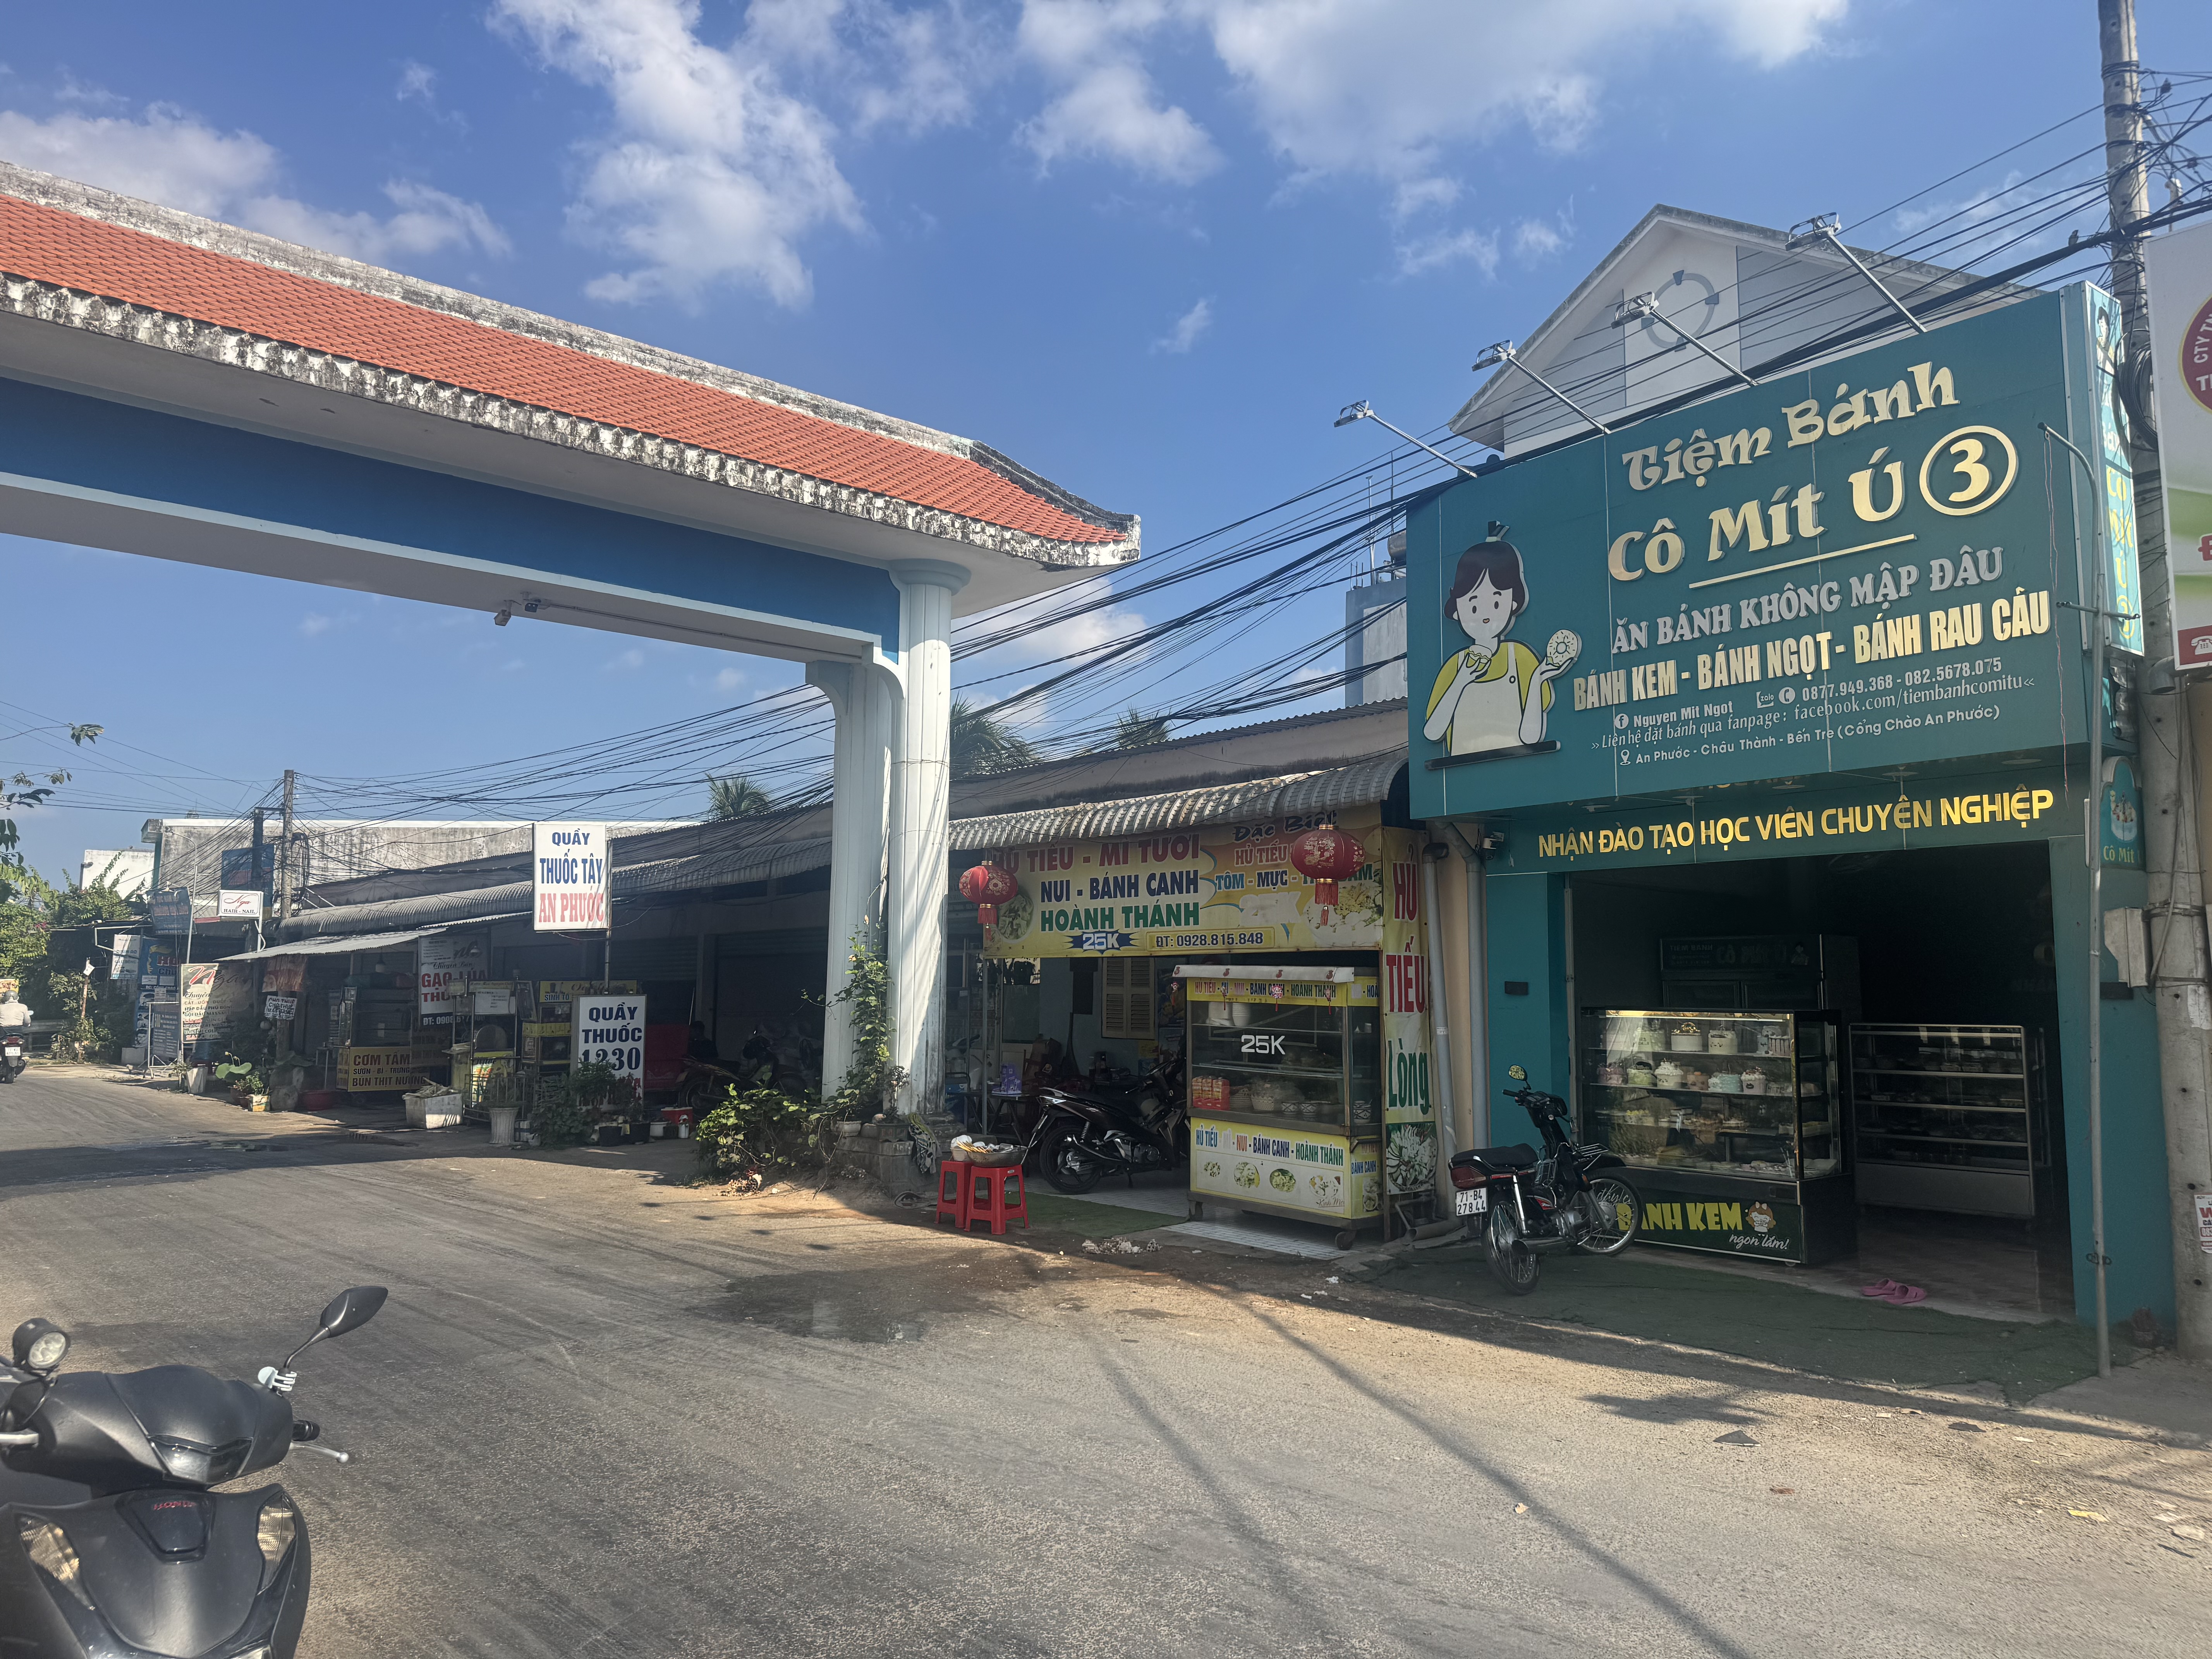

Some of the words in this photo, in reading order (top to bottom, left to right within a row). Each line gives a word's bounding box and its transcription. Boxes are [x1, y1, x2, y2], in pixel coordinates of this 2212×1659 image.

[1622, 427, 1772, 491] Tiệm
[1782, 361, 1960, 448] Bánh
[1608, 517, 1685, 581] Cô
[1708, 483, 1827, 561] Mít
[1848, 446, 1905, 522] Ú
[1948, 438, 1991, 502] 3
[1612, 618, 1649, 654] ĂN
[1657, 603, 1732, 644] BÁNH
[1740, 582, 1842, 629] KHÔNG
[1850, 562, 1919, 610] MẬP
[1930, 544, 2003, 591] ĐÂU
[1573, 669, 1627, 711] BÁNH
[1632, 659, 1678, 701] KEM
[1697, 644, 1761, 690] BÁNH
[1767, 631, 1832, 680] NGỌT
[1853, 613, 1922, 664] BÁNH
[1930, 603, 1983, 651] RAU
[1992, 586, 2051, 641] CÂU
[1760, 693, 1774, 702] zalo
[1802, 675, 1893, 702] 0877.949.368
[1905, 657, 2002, 686] 082.5678.075
[1602, 731, 1626, 748] Liên
[1628, 730, 1642, 748] hệ
[1644, 725, 1663, 745] đặt
[1666, 720, 1696, 739] bánh
[1700, 721, 1722, 738] qua
[1795, 675, 2022, 720] facebook.com/tiembanhcomitu
[1634, 711, 1677, 728] Nguyen
[1636, 752, 1651, 764] An
[1654, 746, 1691, 762] Phước
[1701, 741, 1734, 755] Châu
[1739, 736, 1776, 750] Thành
[1787, 728, 1810, 745] Bến
[1815, 728, 1834, 742] Tre
[1837, 719, 1881, 740] (Cổng
[1885, 715, 1922, 731] Chào
[1924, 712, 1944, 726] An
[1947, 704, 2000, 724] Phước)
[552, 828, 591, 847] QUẦY
[1233, 822, 1275, 842] Đặc
[1539, 826, 1594, 861] NHẬN
[1598, 822, 1644, 854] ĐÀO
[1648, 821, 1694, 855] TẠO
[1700, 816, 1749, 852] HỌC
[1755, 805, 1814, 840] VIÊN
[1820, 795, 1933, 835] CHUYÊN
[1940, 783, 2054, 829] NGHIỆP
[539, 848, 578, 884] THUỐC
[581, 853, 603, 884] TÂY
[1026, 840, 1074, 872] TIẾU
[1138, 834, 1200, 864] TƯƠI
[1235, 843, 1254, 866] HỦ
[1256, 840, 1288, 864] TIẾU
[2103, 845, 2116, 862] Cô
[2119, 847, 2135, 864] Mít
[1041, 879, 1070, 903] NUI
[1090, 871, 1139, 900] BÁNH
[1146, 869, 1199, 897] CANH
[1215, 871, 1245, 891] TÔM
[1256, 869, 1288, 890] MỰC
[1393, 842, 1417, 921] HỦ
[539, 893, 557, 923] AN
[560, 885, 604, 922] PHƯỚC
[1041, 904, 1114, 932] HOÀNH
[1121, 899, 1200, 929] THÁNH
[1082, 932, 1120, 950] 25K
[1156, 935, 1174, 947] ĐT:
[1176, 931, 1264, 947] 0928.815.848
[1250, 980, 1267, 995] BÁNH
[1386, 936, 1425, 1014] TIẾU
[589, 1002, 638, 1023] QUẦY
[582, 1022, 642, 1044] THUỐC
[1241, 1034, 1286, 1056] 25K
[353, 1053, 381, 1066] CƠM
[1386, 1038, 1430, 1116] Lòng
[1196, 1125, 1204, 1146] HỦ
[1205, 1126, 1218, 1148] TIẾU
[1236, 1134, 1248, 1152] NUI
[1253, 1133, 1271, 1156] BÁNH
[1272, 1139, 1290, 1158] CANH
[1296, 1140, 1319, 1163] HOÀNH
[1320, 1144, 1343, 1166] THÁNH
[1351, 1159, 1364, 1175] BÁNH
[1364, 1160, 1376, 1173] CANH
[1457, 1200, 1486, 1215] 278.44
[1686, 1202, 1743, 1231] KEM
[1729, 1233, 1759, 1250] ngon
